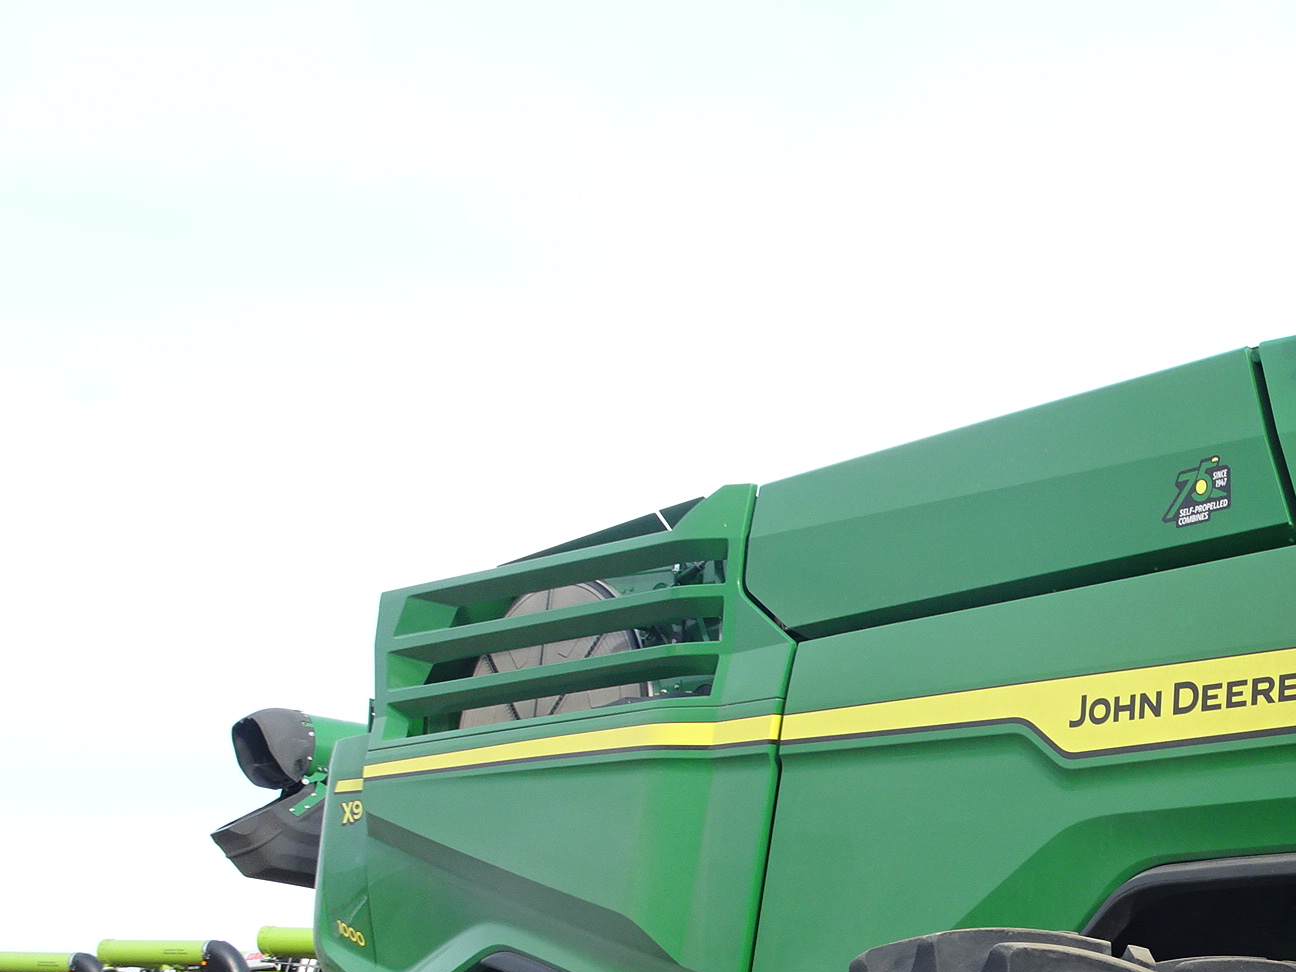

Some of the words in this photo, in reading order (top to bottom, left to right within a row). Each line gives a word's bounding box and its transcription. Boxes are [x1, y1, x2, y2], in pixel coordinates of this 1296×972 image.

[1212, 469, 1228, 480] SINCE
[1215, 477, 1228, 488] 1947
[1179, 499, 1228, 517] SELF-PROPELLED
[1178, 512, 1209, 526] COMBINES
[1068, 690, 1162, 729] JOHN
[341, 800, 364, 825] X9
[337, 920, 366, 947] 1000
